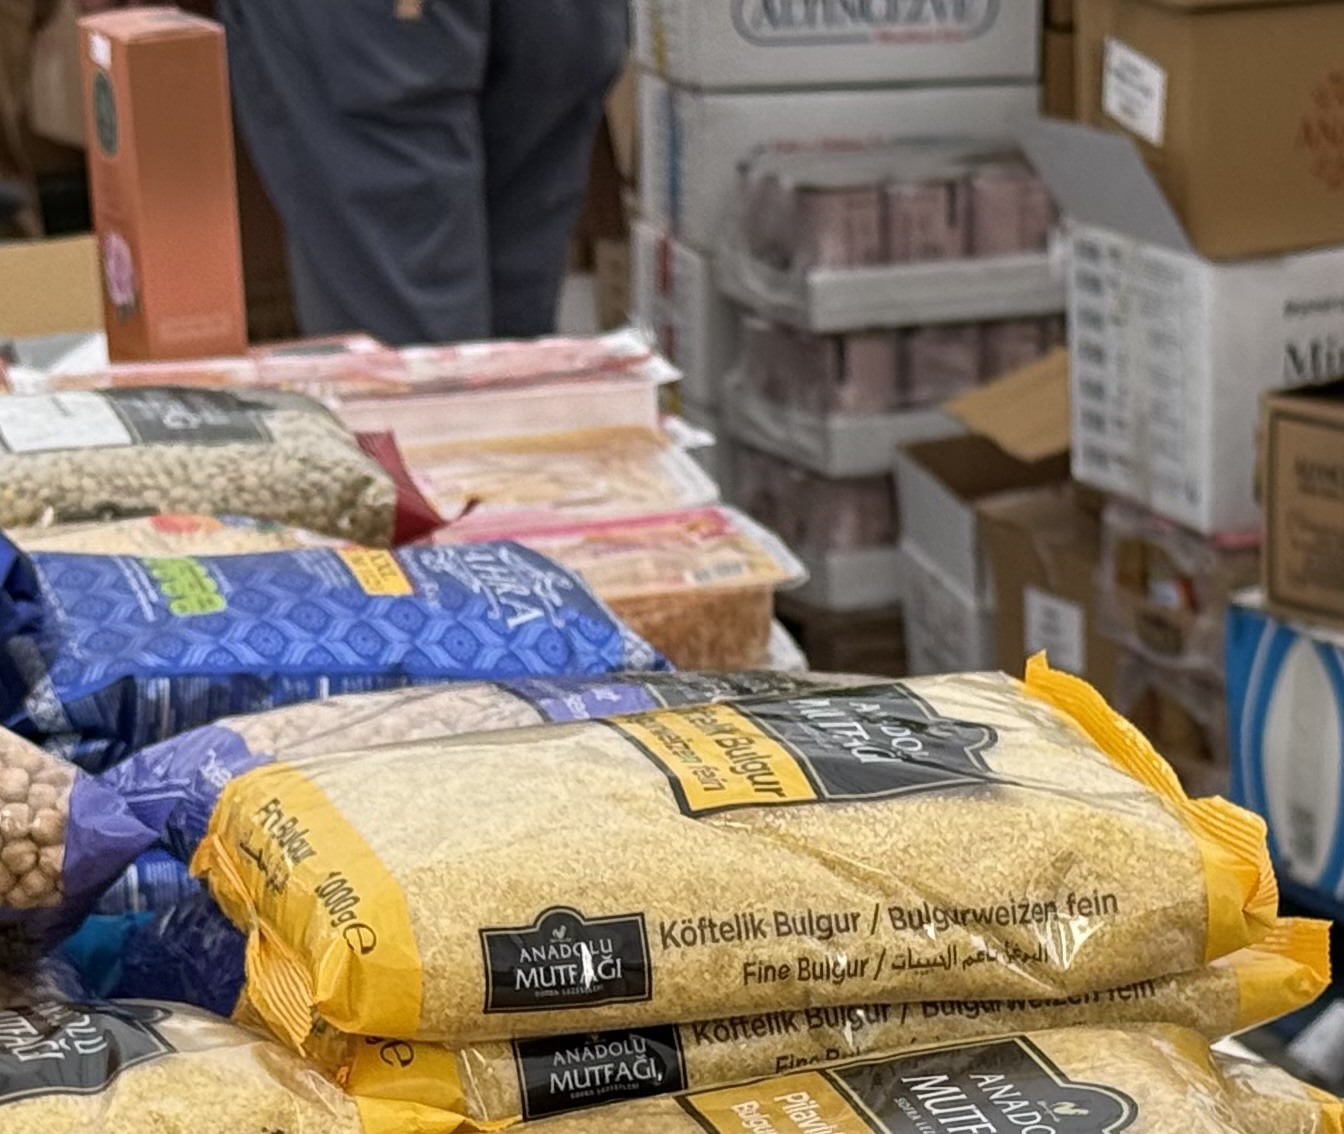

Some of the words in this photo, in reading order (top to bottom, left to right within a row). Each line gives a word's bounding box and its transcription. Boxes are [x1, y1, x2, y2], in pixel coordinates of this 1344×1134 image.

[659, 913, 767, 951] Köftelik
[772, 908, 862, 947] Bulgur
[1064, 889, 1120, 924] fein
[519, 937, 614, 963] ANADOLU
[514, 954, 623, 991] MUTFAĞI
[743, 956, 790, 987] Fine
[796, 951, 868, 989] Bulgur
[552, 1037, 647, 1067] ANADOLU
[549, 1054, 657, 1094] MUTFAĞI
